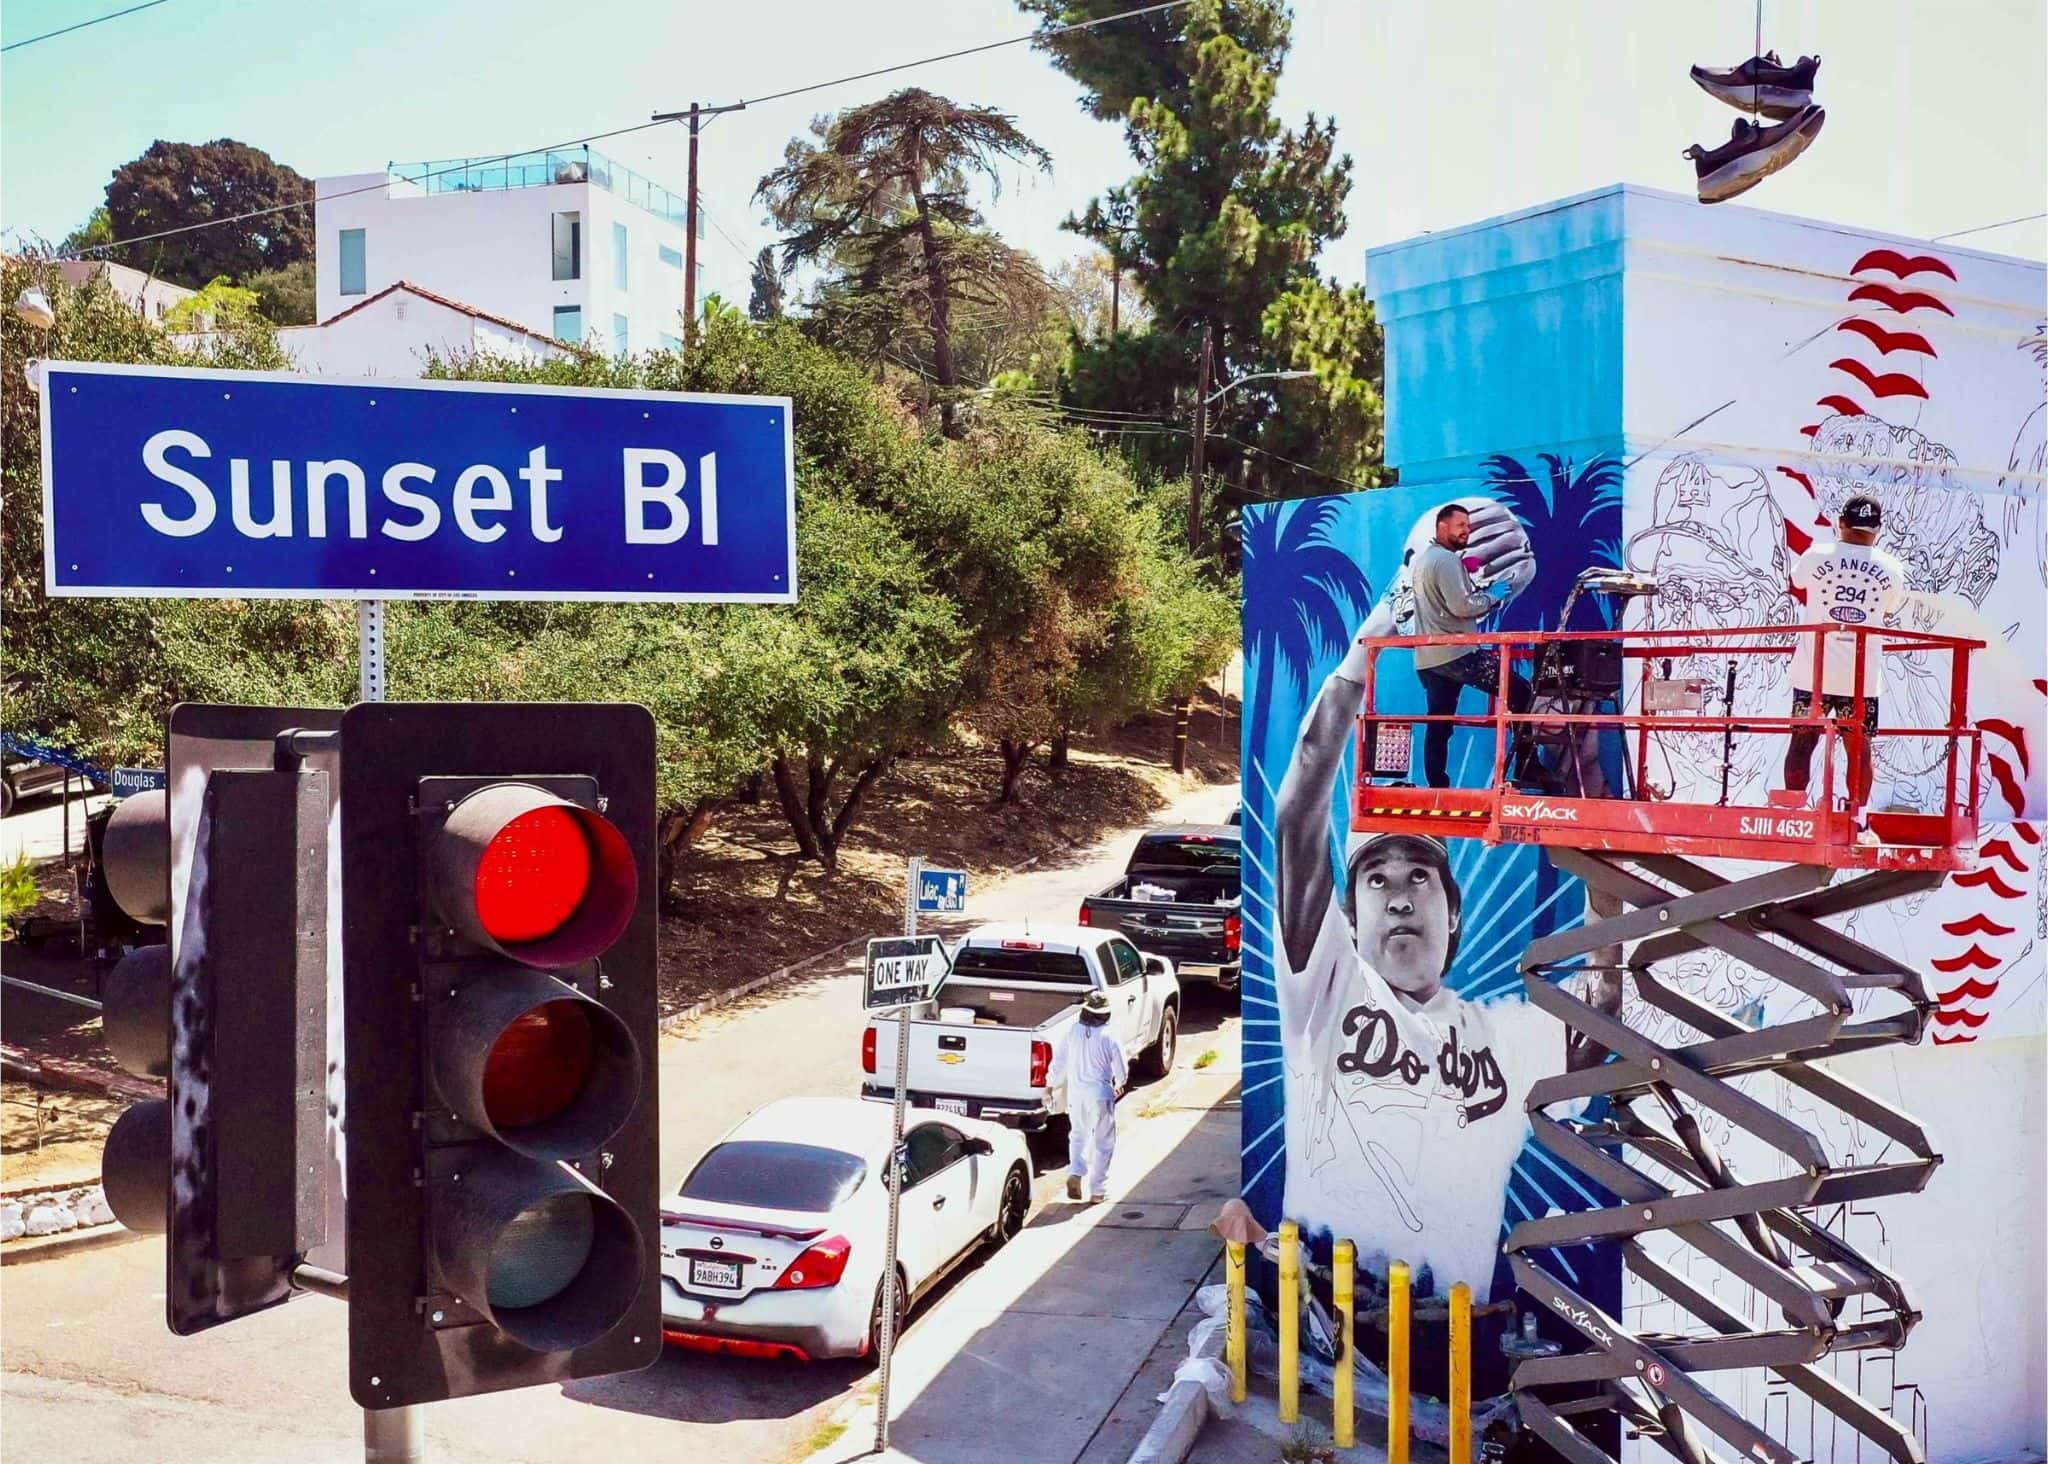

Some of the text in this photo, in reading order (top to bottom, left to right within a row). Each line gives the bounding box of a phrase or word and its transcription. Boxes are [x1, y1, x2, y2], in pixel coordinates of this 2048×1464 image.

[140, 429, 719, 546] Sunset Bl
[1812, 558, 1891, 591] LOS ANGELES
[1835, 585, 1867, 605] 294
[114, 770, 156, 792] Douglas
[1502, 799, 1579, 822] SKYJACK
[1776, 818, 1814, 839] 4632
[876, 959, 929, 985] ONE WAY
[1552, 1296, 1614, 1348] SKYJACK
